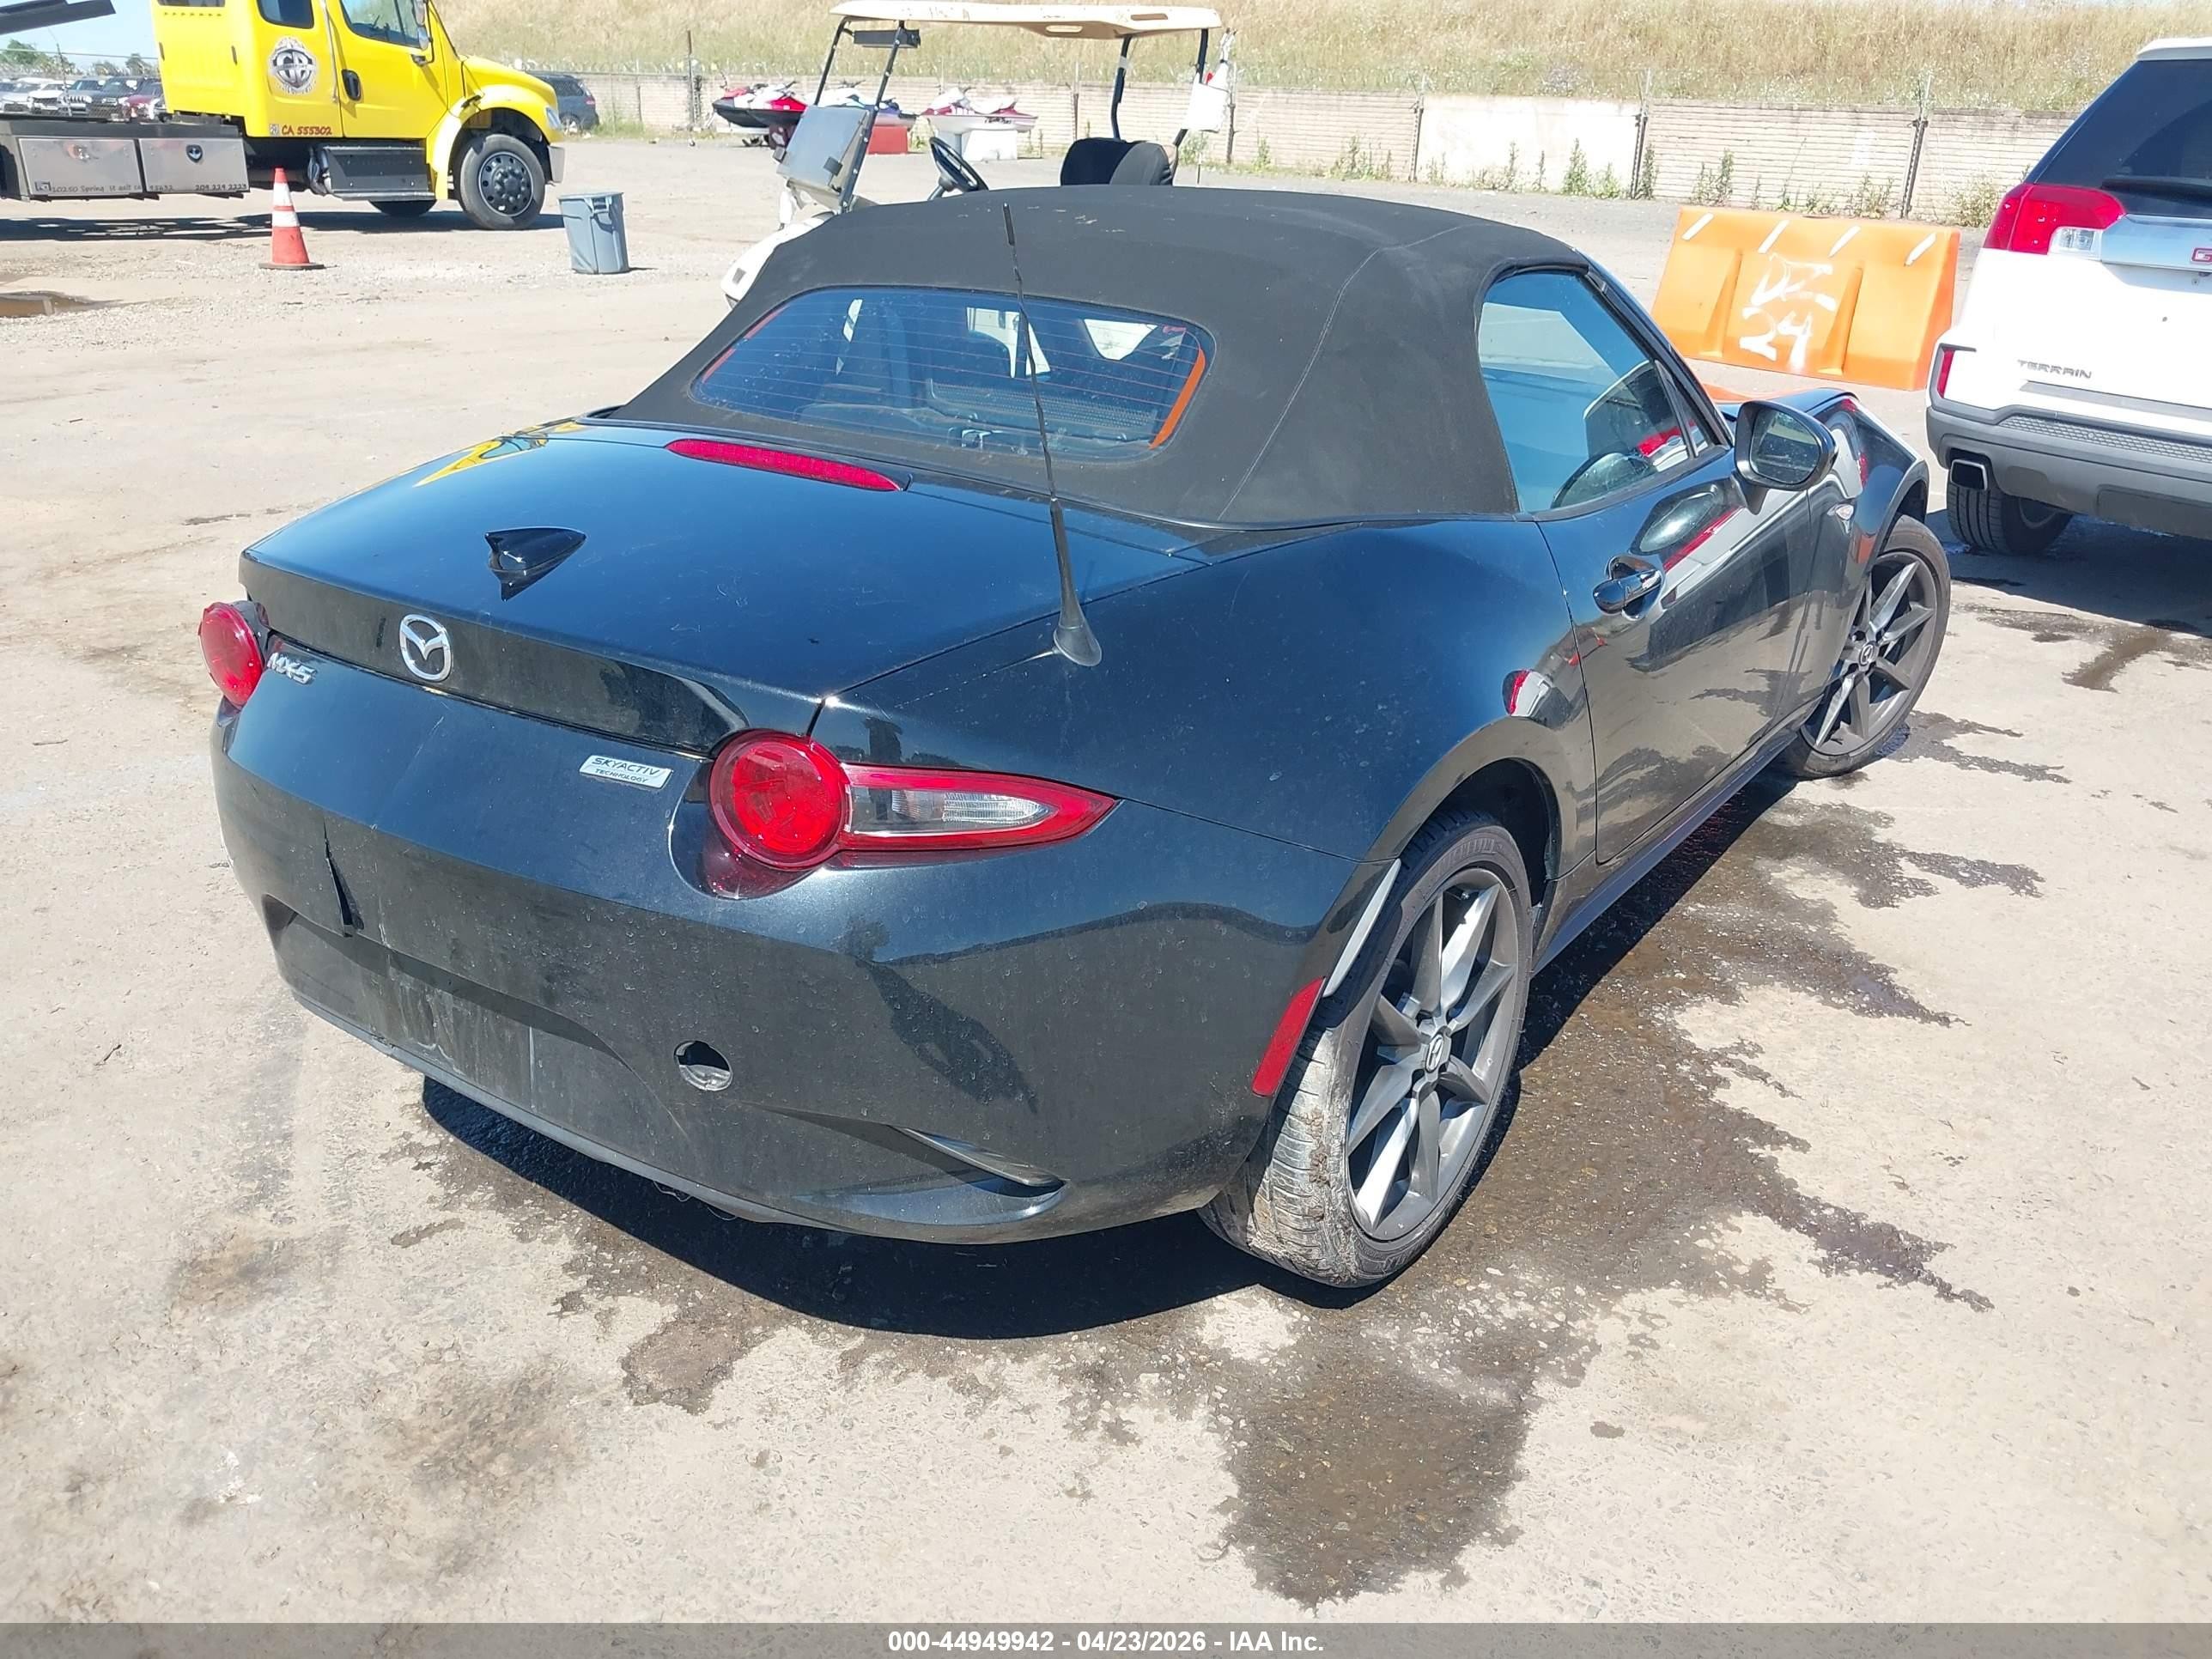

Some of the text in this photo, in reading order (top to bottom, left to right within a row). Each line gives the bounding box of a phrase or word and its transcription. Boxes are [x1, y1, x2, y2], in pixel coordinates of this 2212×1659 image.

[282, 125, 295, 136] CA
[1739, 307, 1813, 369] 24
[2017, 359, 2092, 379] TERRAIN
[592, 757, 660, 775] SKYACTIV
[594, 768, 649, 783] TECHNOLOGY
